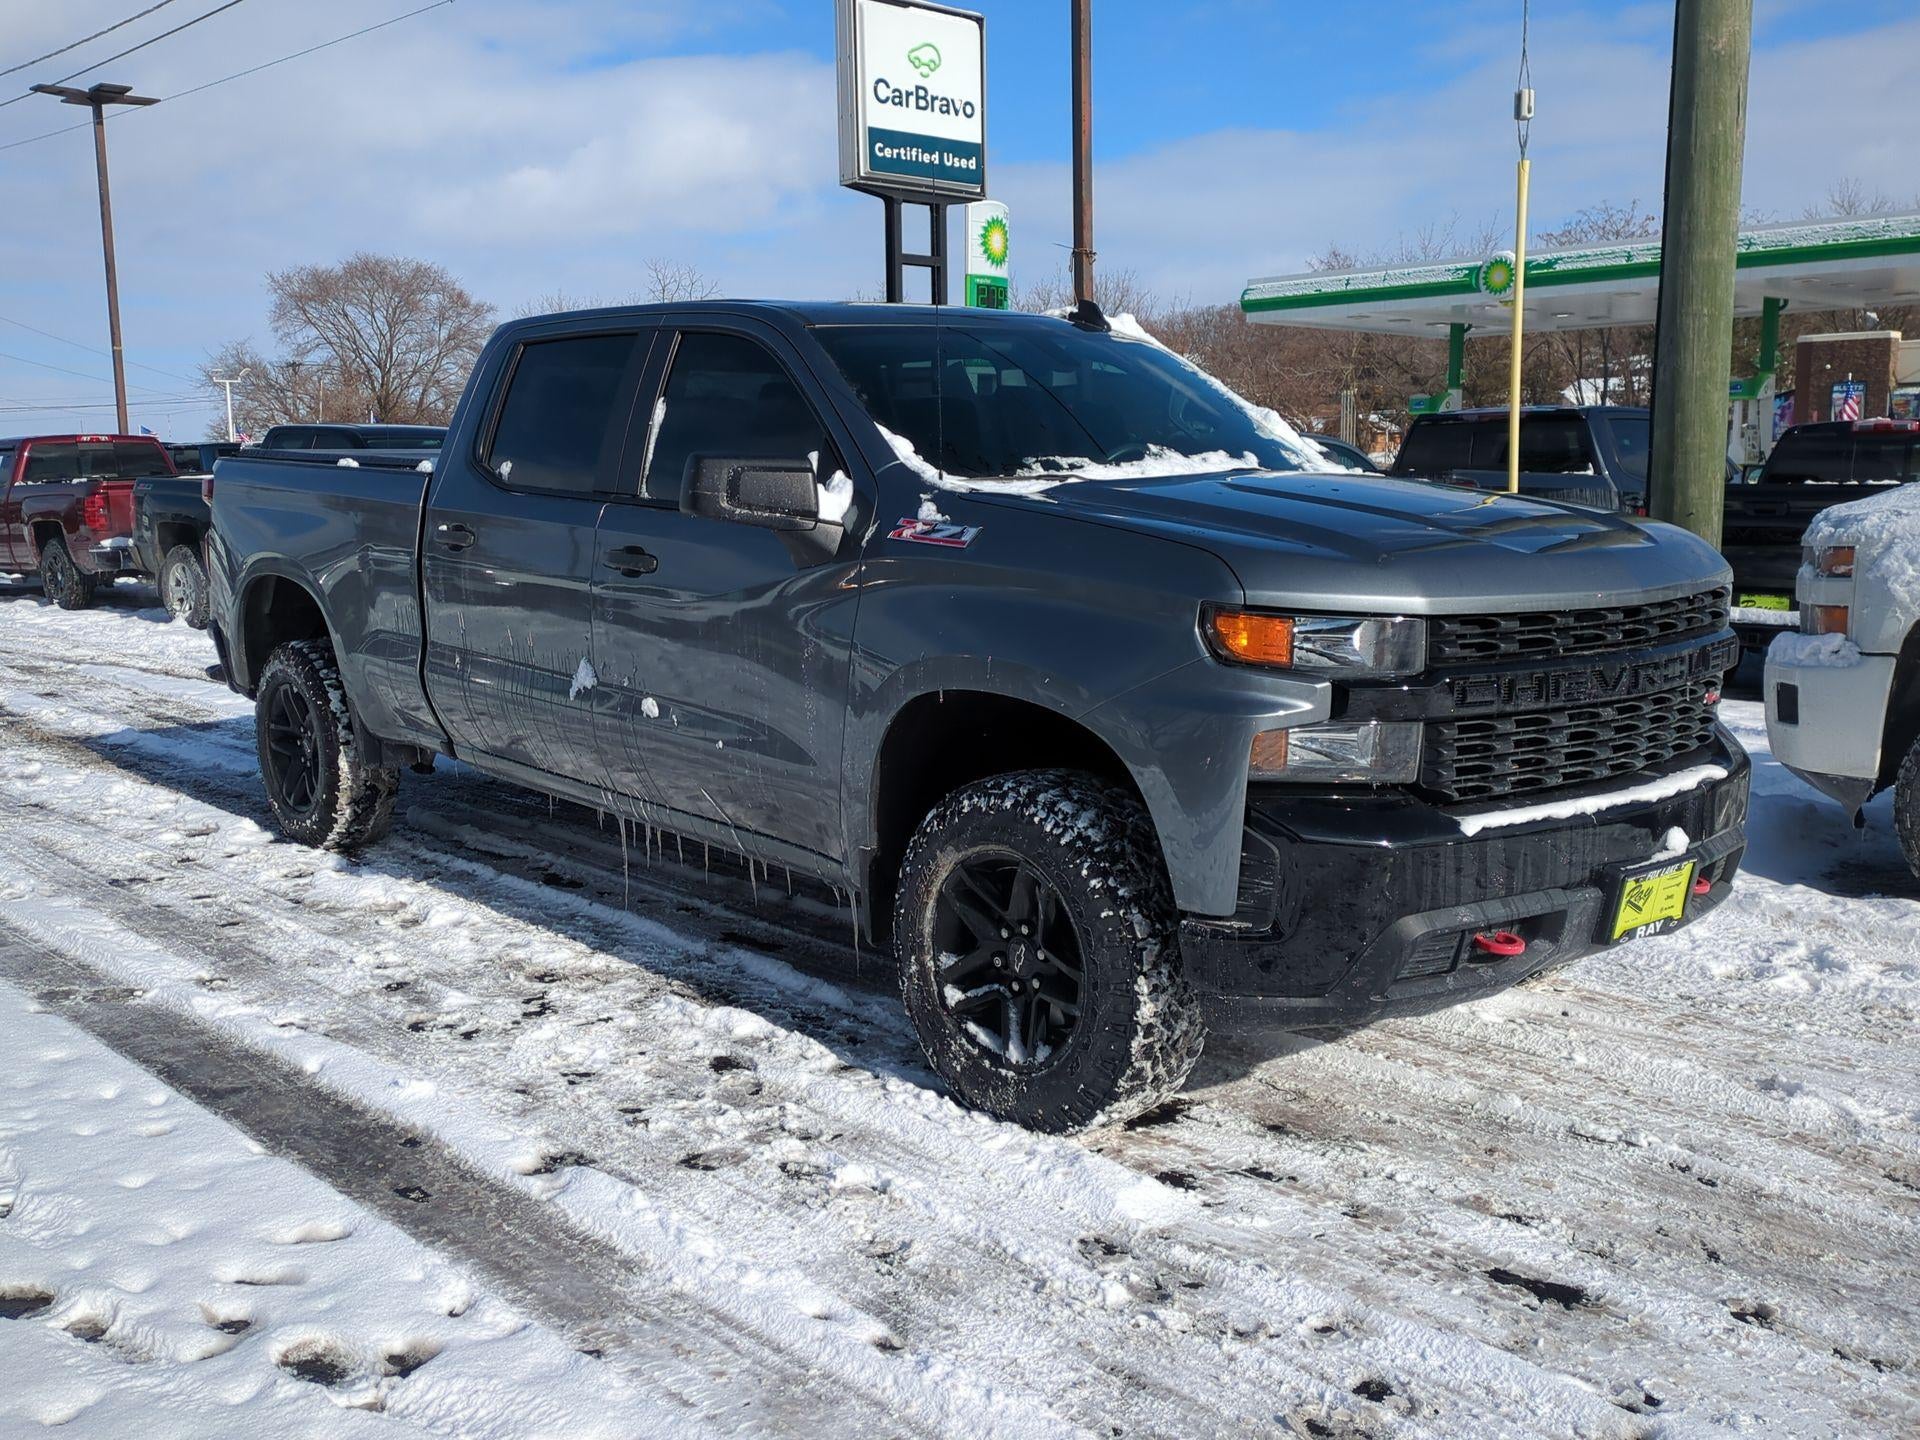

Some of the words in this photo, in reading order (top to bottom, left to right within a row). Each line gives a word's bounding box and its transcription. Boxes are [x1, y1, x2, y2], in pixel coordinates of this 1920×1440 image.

[873, 78, 975, 119] CarBravo
[874, 142, 939, 165] Certified
[944, 152, 977, 170] Used
[1454, 640, 1738, 707] CHEVROLET
[1637, 920, 1664, 938] RAY
